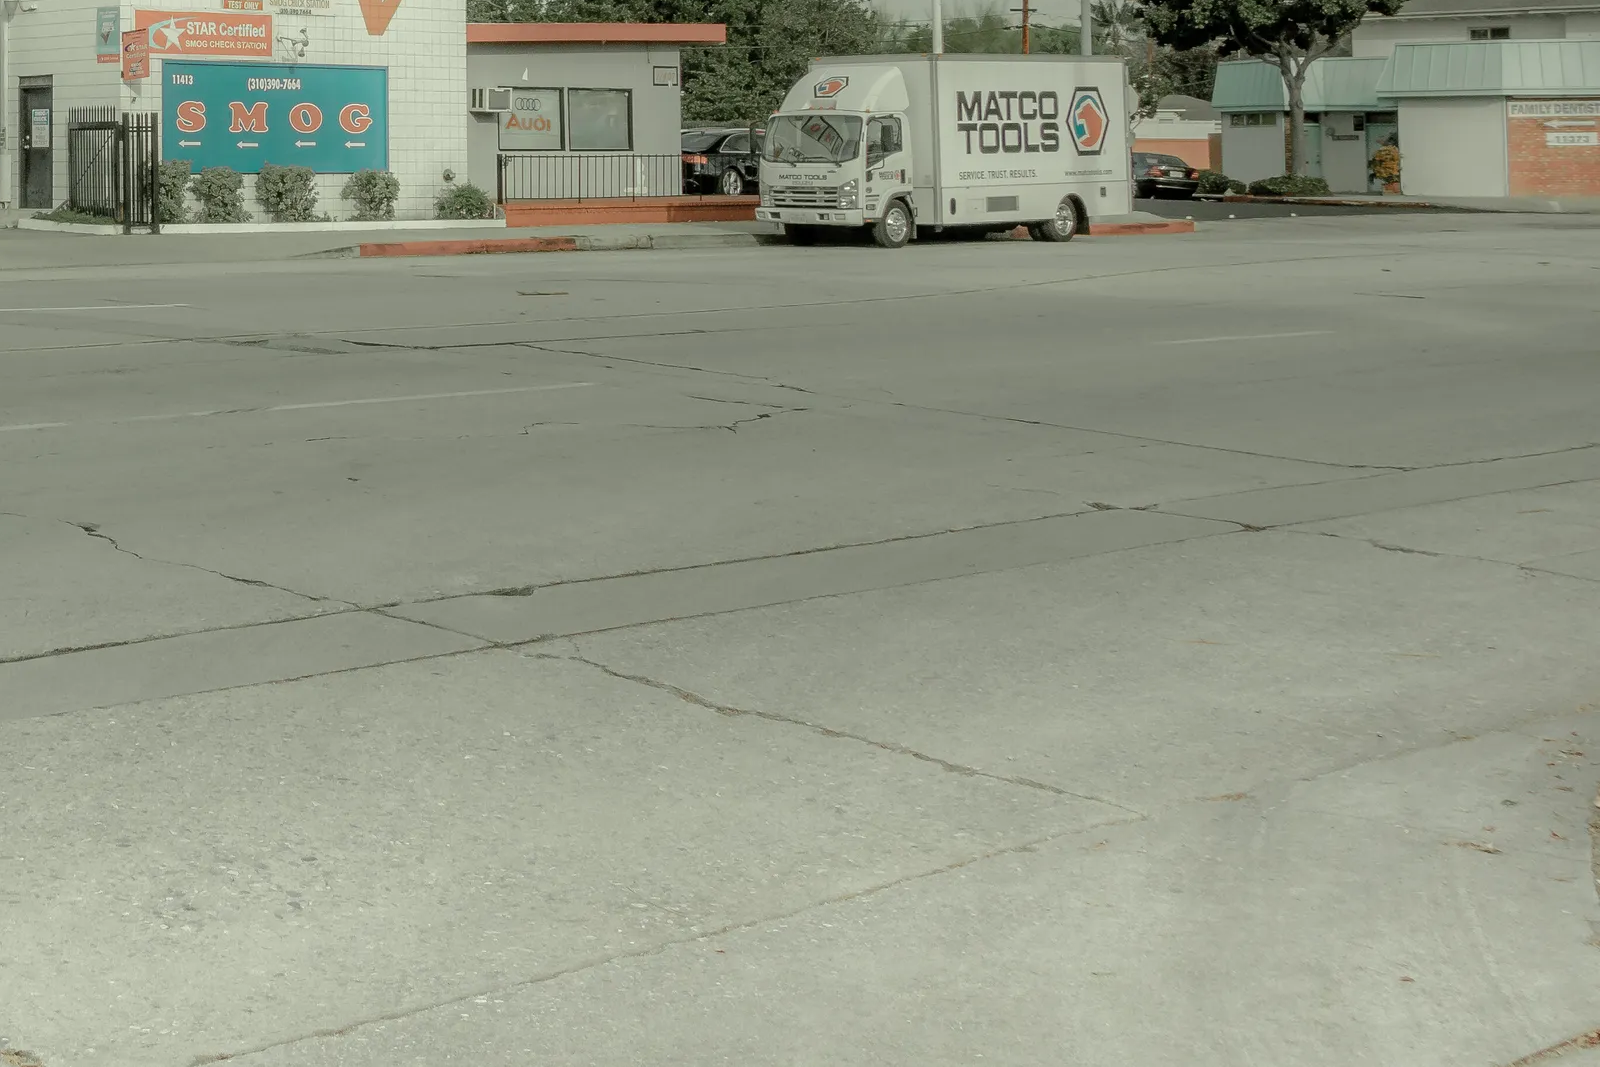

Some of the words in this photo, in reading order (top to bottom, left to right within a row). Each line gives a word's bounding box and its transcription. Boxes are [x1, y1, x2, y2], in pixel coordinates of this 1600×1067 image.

[227, 0, 243, 10] TEST
[243, 1, 260, 10] ONLY
[306, 0, 330, 9] STATION
[186, 21, 217, 36] STAR
[219, 22, 266, 37] Certified
[185, 39, 208, 48] SMOG
[209, 40, 235, 49] CHECK
[236, 41, 267, 50] STATION
[171, 74, 194, 85] 11413
[247, 77, 301, 92] (310)390-7664
[956, 90, 1059, 122] MATCO
[1510, 104, 1552, 115] FAMILY
[176, 100, 373, 134] SMOG
[957, 122, 1060, 155] TOOLS
[958, 170, 987, 180] SERVICE.
[987, 170, 1009, 179] TRUST.
[1009, 169, 1038, 179] RESULTS.
